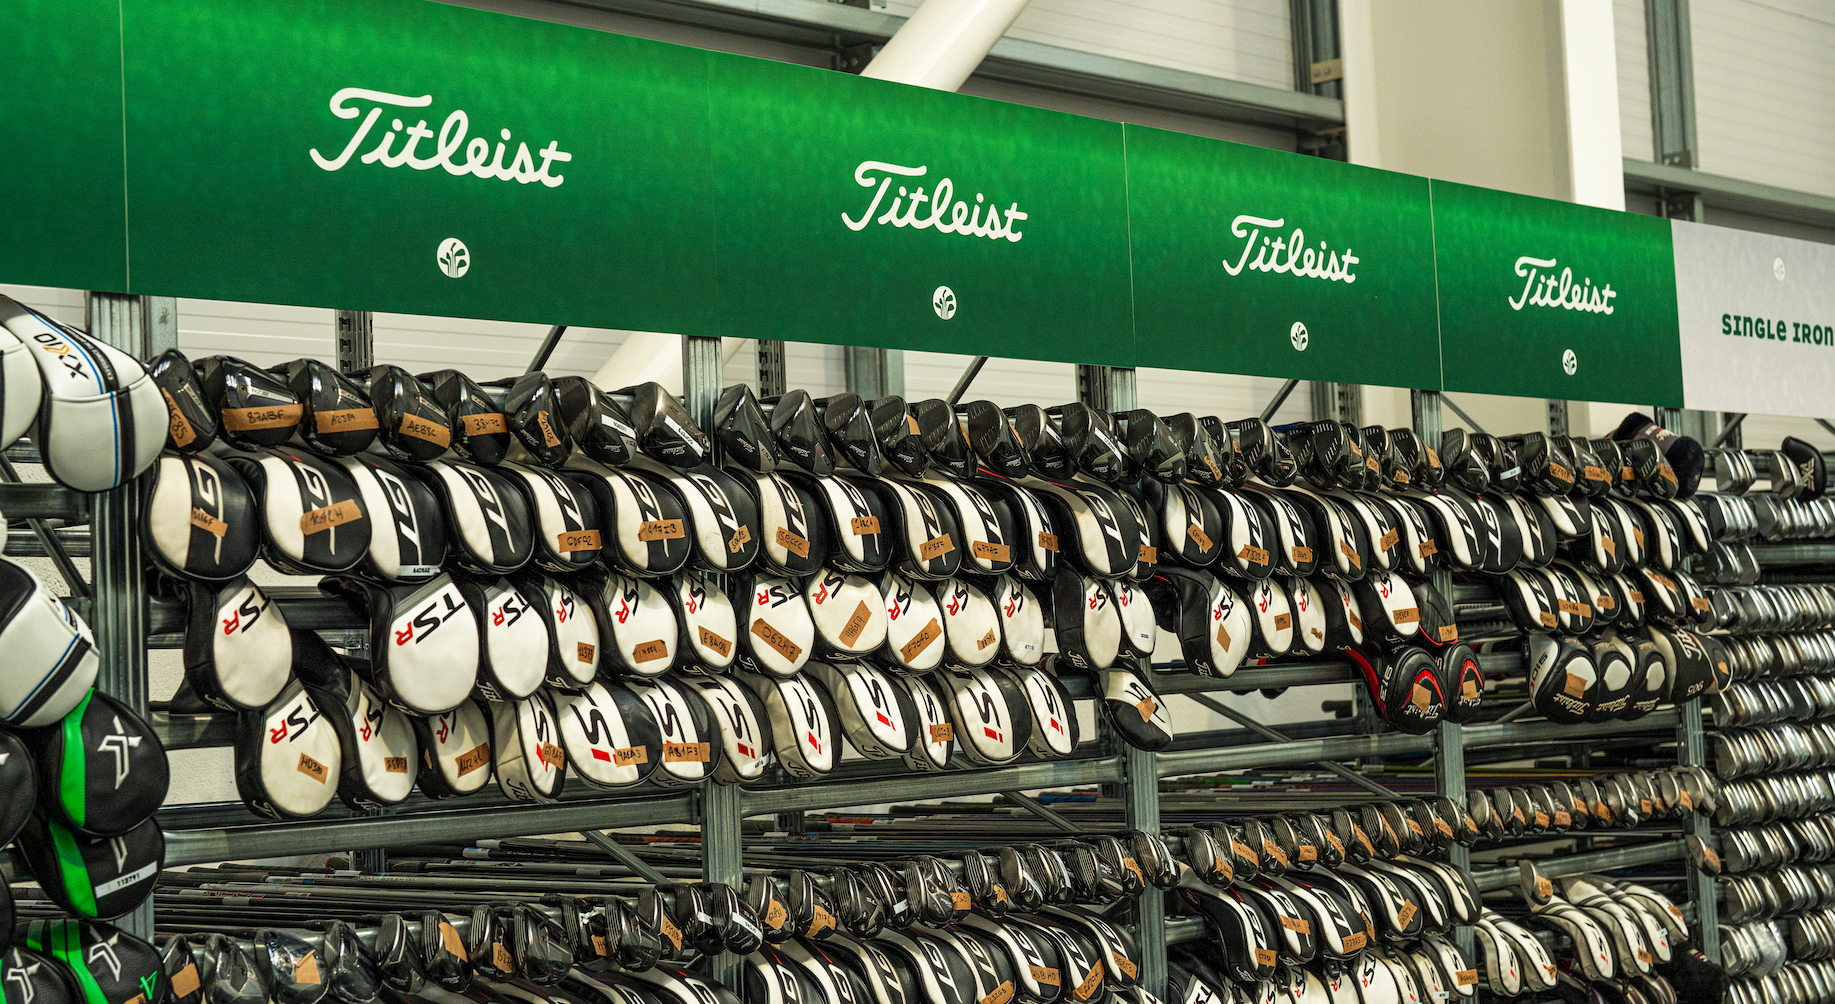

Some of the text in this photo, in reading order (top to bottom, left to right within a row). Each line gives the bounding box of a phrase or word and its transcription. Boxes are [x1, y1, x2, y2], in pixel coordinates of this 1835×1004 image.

[309, 87, 573, 188] Titleist
[841, 160, 1028, 243] Titleist
[1222, 214, 1360, 284] Titleist
[1508, 256, 1617, 316] Titleist
[1721, 313, 1834, 347] SINGLE IRON
[375, 468, 423, 565] GT
[456, 465, 516, 553] GT
[1077, 490, 1128, 560] GT
[1435, 493, 1481, 556] GT
[1478, 499, 1502, 566] GT
[395, 592, 467, 646] TSR
[492, 591, 532, 627] TSR
[757, 581, 803, 609] TSR
[270, 695, 323, 745] TSR
[560, 688, 618, 765] TSi
[631, 680, 687, 745] TS
[697, 681, 756, 759] TSi
[955, 671, 1004, 744] TSi
[1552, 692, 1591, 716] Titleist
[917, 936, 964, 1004] GT
